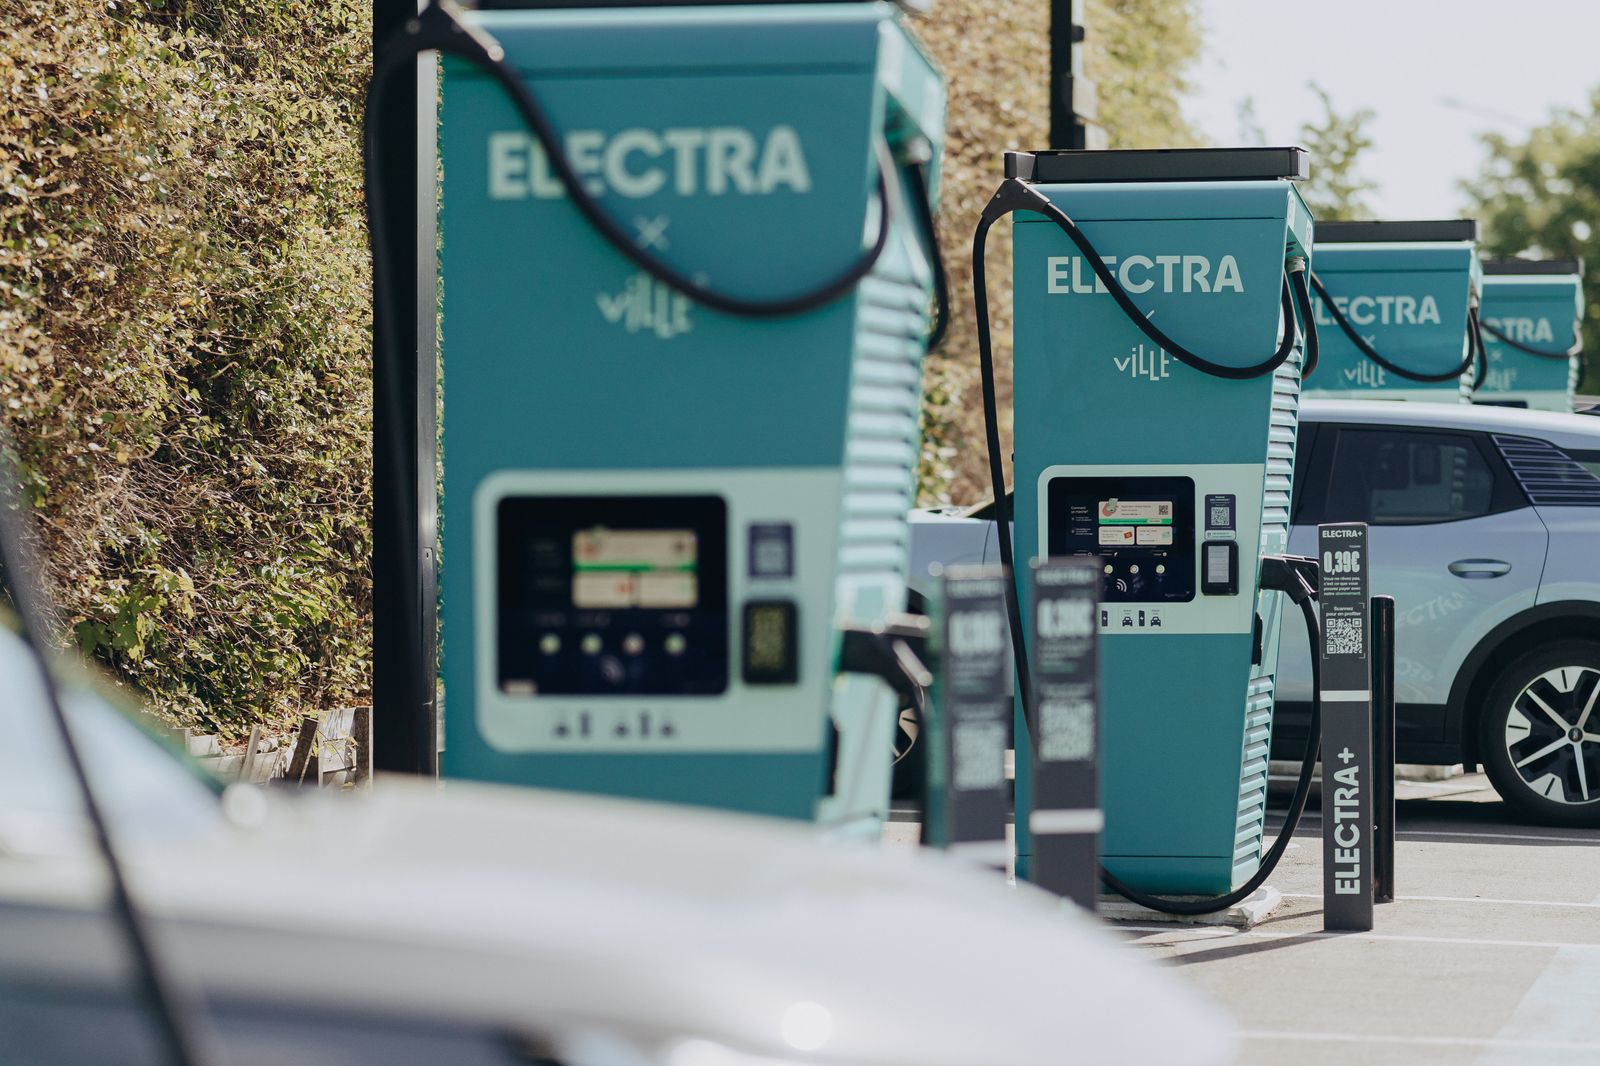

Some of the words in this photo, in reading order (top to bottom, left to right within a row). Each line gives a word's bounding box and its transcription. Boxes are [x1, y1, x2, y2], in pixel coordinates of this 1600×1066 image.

[486, 124, 814, 201] ELECTRA
[1309, 293, 1442, 327] LECTRA
[1323, 551, 1360, 576] 0,39€
[1334, 747, 1361, 895] ELECTRA+
